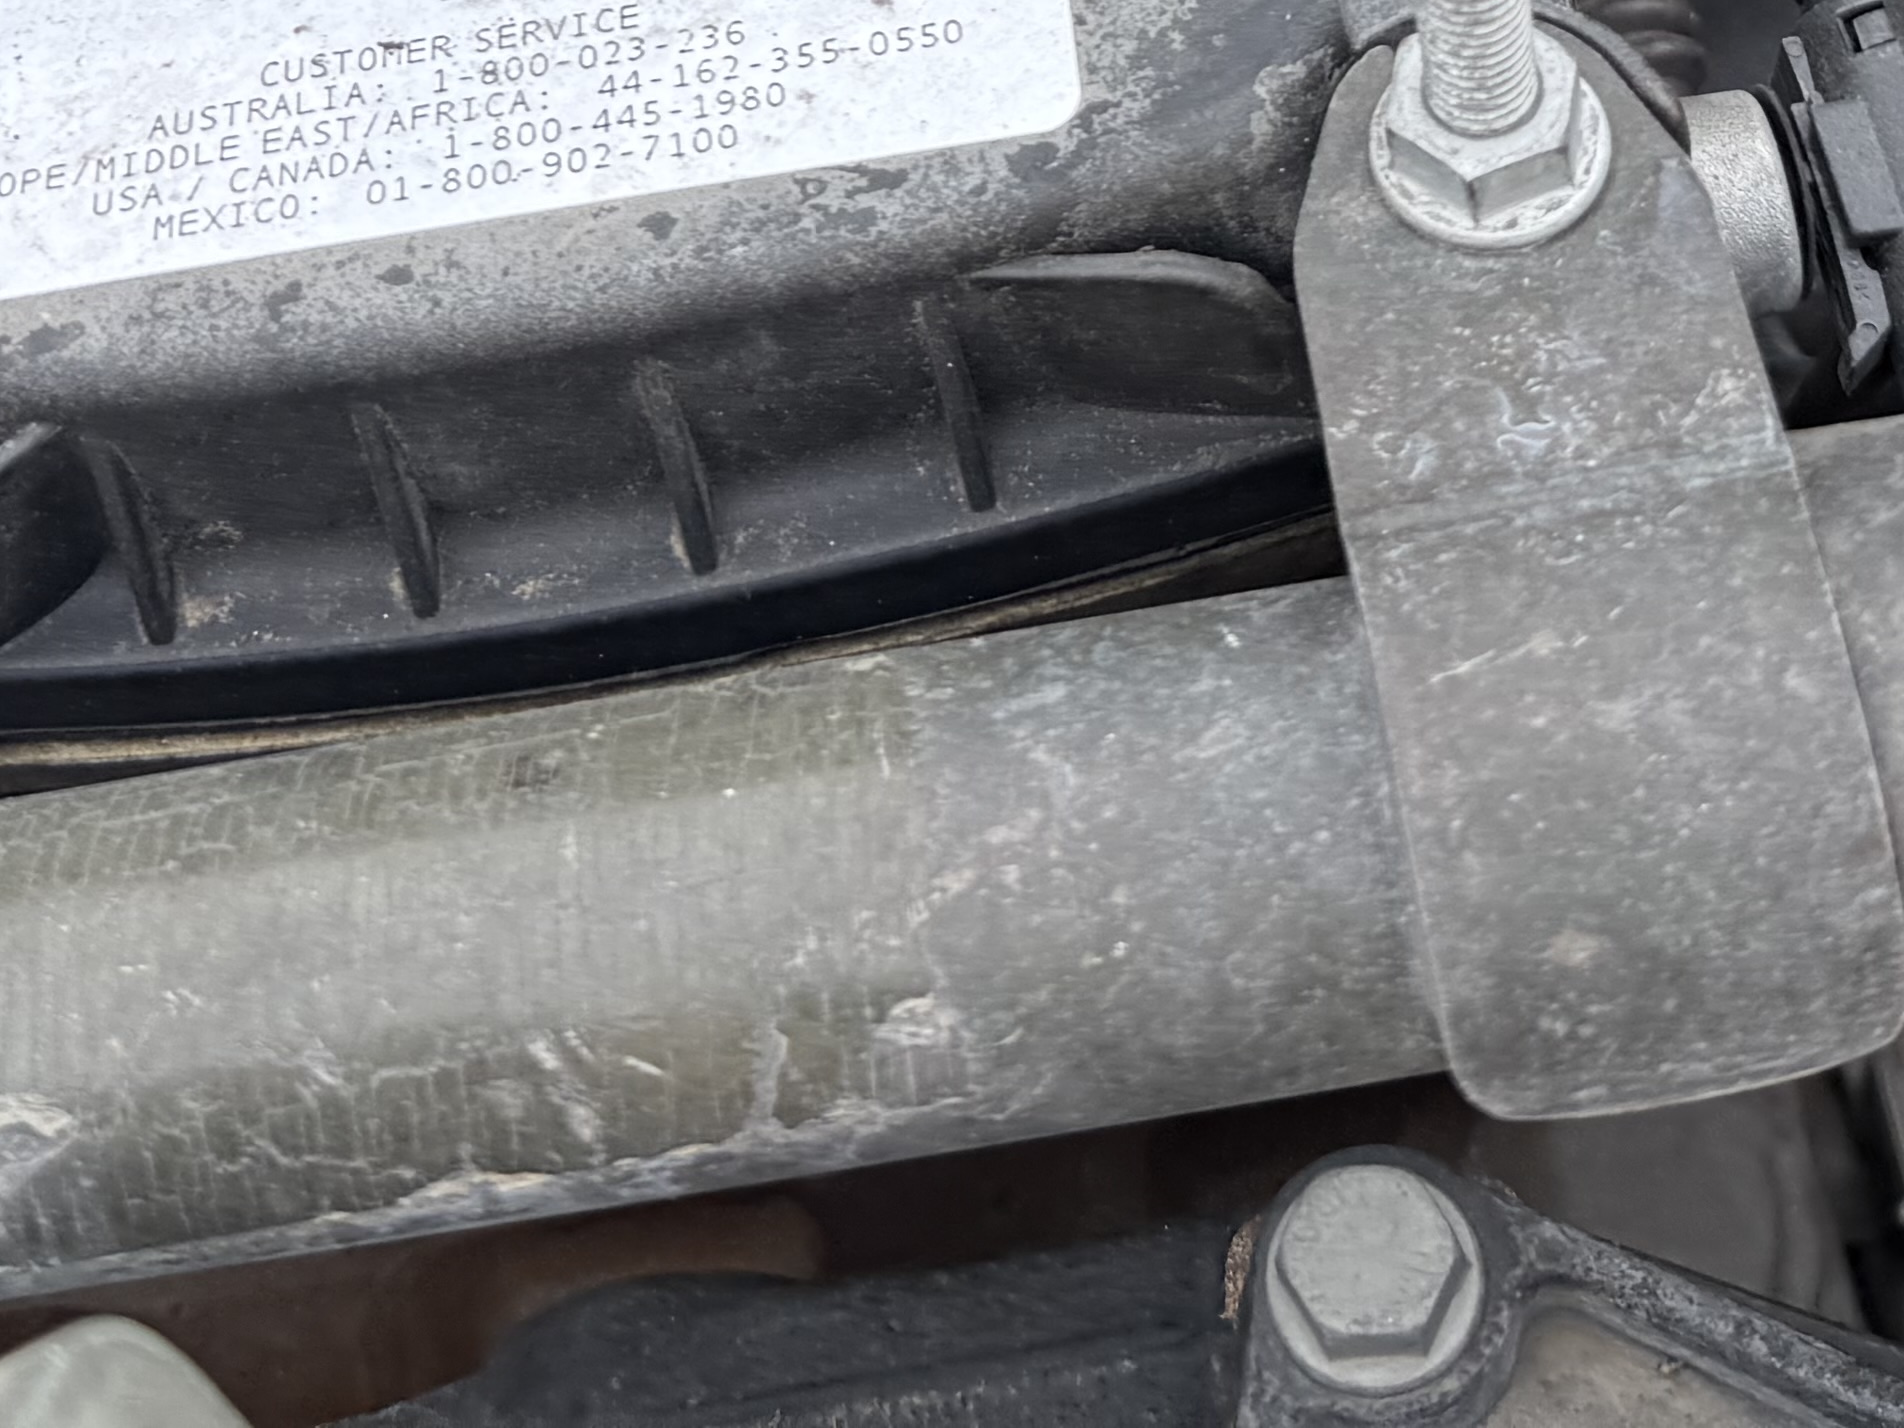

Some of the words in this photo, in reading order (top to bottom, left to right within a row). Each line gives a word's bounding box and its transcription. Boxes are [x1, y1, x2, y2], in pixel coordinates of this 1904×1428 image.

[147, 76, 385, 140] AUSTRALIA:
[432, 19, 745, 94] 1-800-023-236
[260, 33, 452, 88] CUSTOMER
[474, 2, 640, 53] SERVICE
[261, 83, 549, 156] EAST/AFRICA:
[597, 17, 964, 101] 44-162-355-0550
[92, 180, 164, 217] USA
[228, 143, 392, 194] CANADA:
[443, 80, 786, 160] 1-800-445-1980
[151, 190, 319, 241] MEXICO:
[366, 123, 738, 207] 01-800-902-7100
